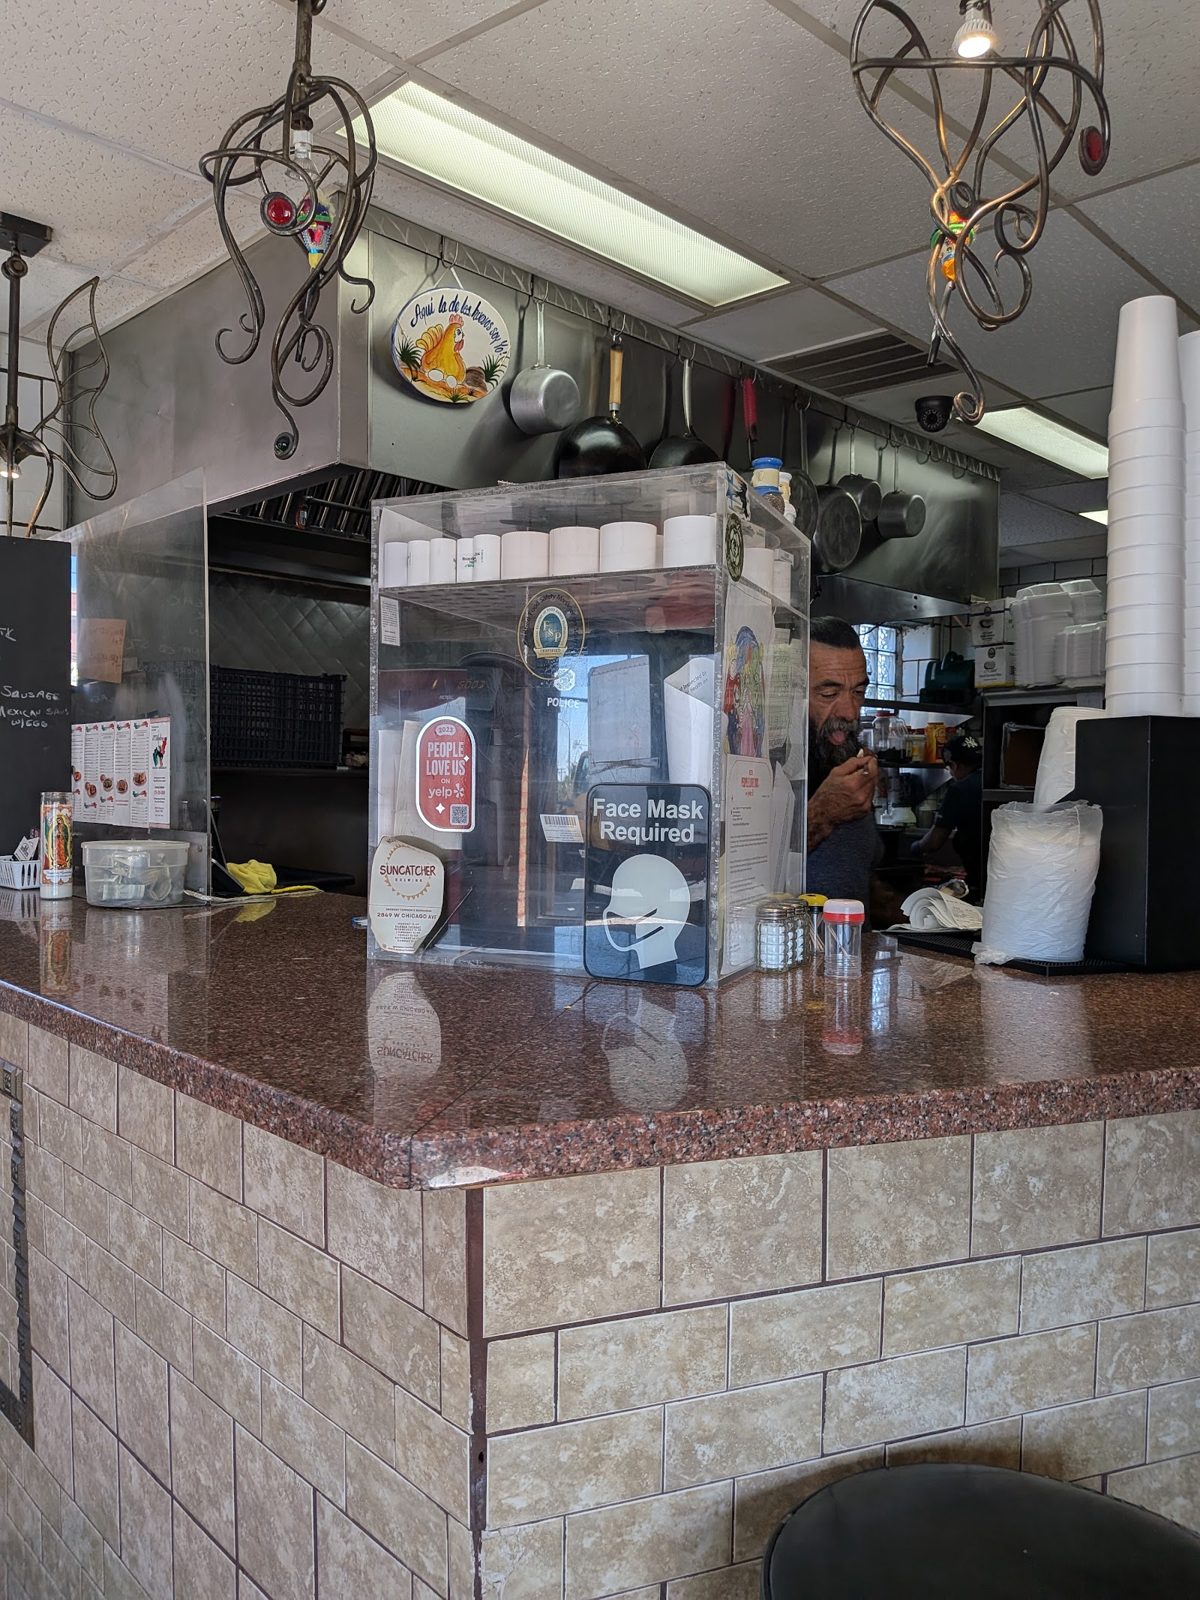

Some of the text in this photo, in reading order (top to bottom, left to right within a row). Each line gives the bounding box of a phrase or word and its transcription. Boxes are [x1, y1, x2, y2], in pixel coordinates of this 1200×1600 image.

[448, 294, 460, 313] de
[546, 697, 580, 709] POLICE
[427, 742, 464, 758] PEOPLE
[426, 760, 466, 776] LOVE US
[428, 786, 453, 799] yelp
[593, 798, 704, 820] Face Mask
[600, 821, 695, 846] Required
[379, 865, 436, 877] SUNCATCHER
